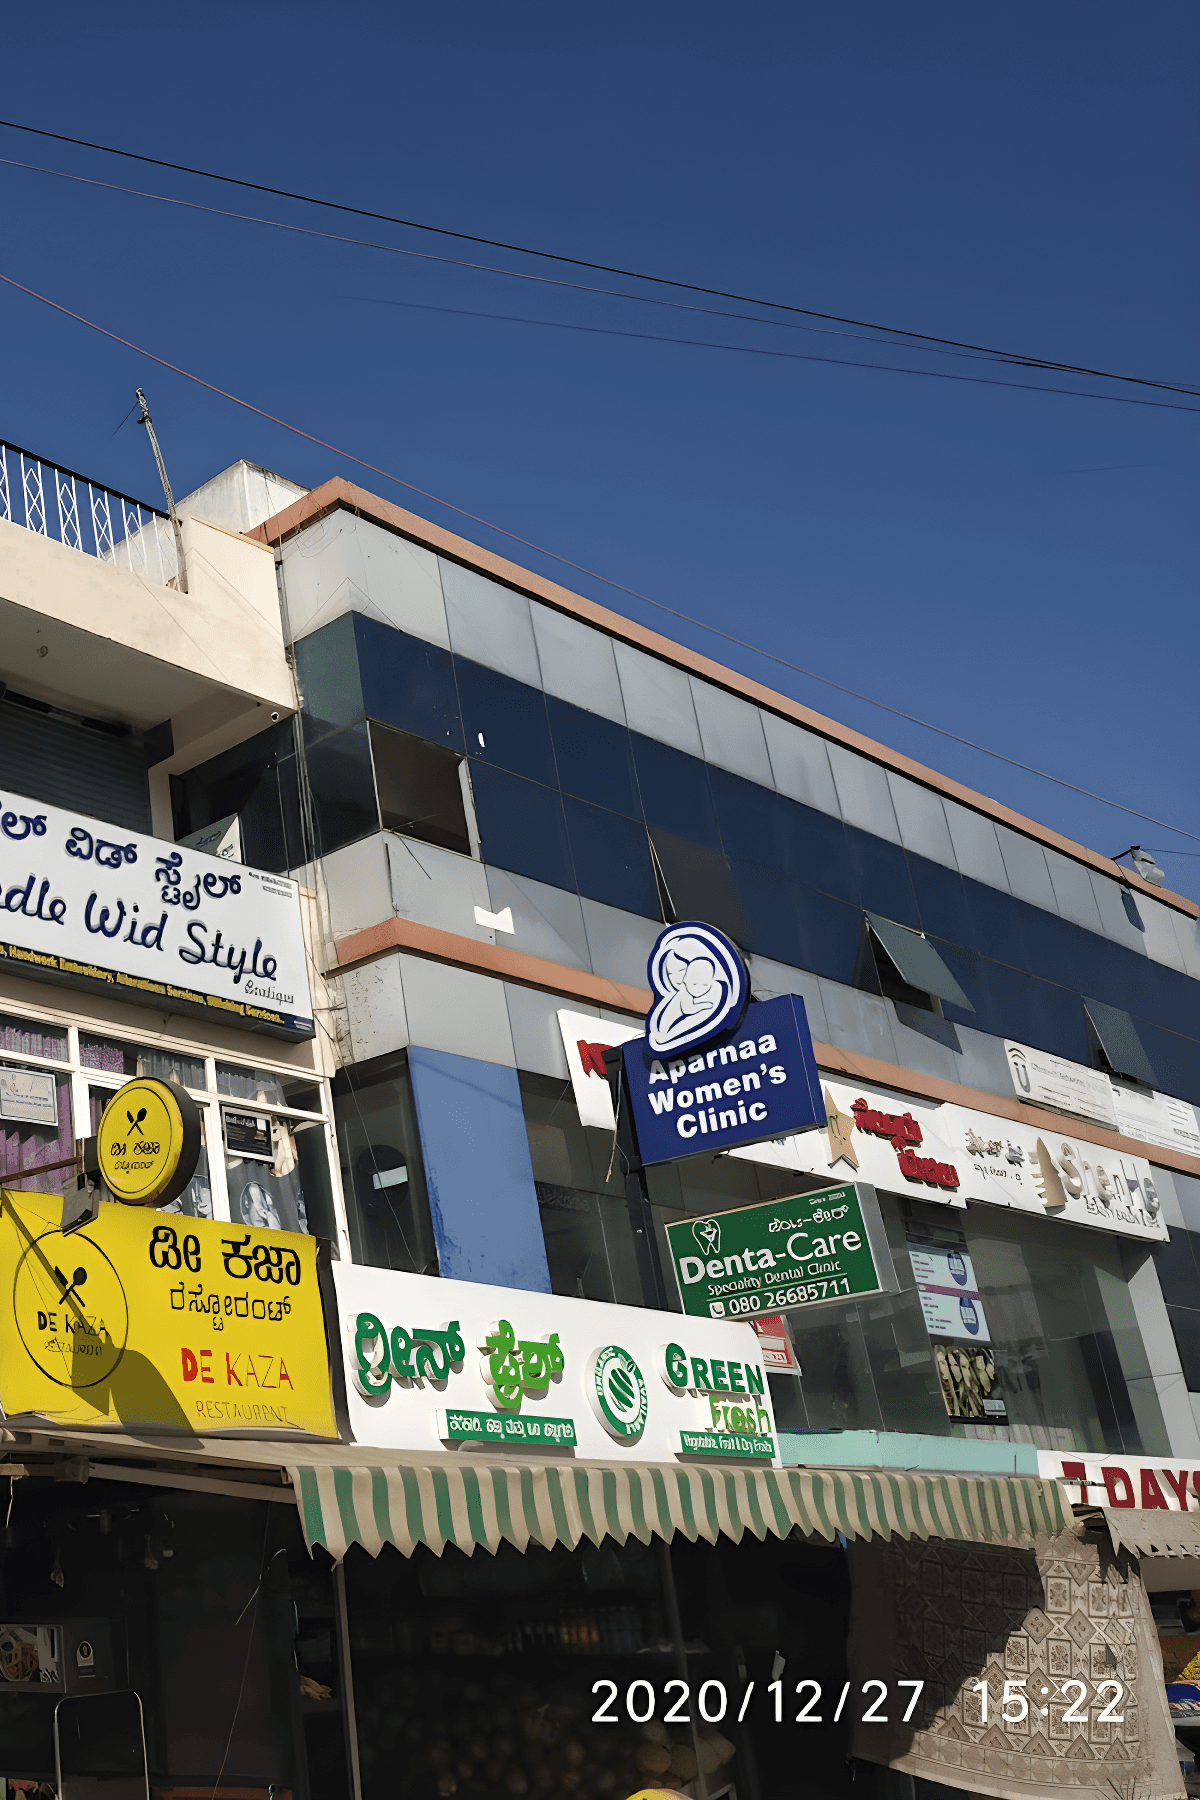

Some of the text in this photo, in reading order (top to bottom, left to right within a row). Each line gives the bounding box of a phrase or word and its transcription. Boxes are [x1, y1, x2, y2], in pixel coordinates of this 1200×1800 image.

[83, 891, 170, 954] Wid
[178, 919, 279, 986] Style
[648, 1034, 778, 1085] Aparnaa
[647, 1062, 788, 1116] Women's
[676, 1099, 768, 1139] Clinic
[678, 1230, 863, 1286] Denta-Care
[764, 1265, 804, 1285] Dental
[807, 1260, 843, 1276] Clinic
[728, 1277, 851, 1315] 080 26685711
[36, 1310, 58, 1332] DE
[180, 1347, 294, 1391] DE KAZA
[665, 1342, 765, 1396] GREEN
[1100, 1465, 1200, 1512] DAY
